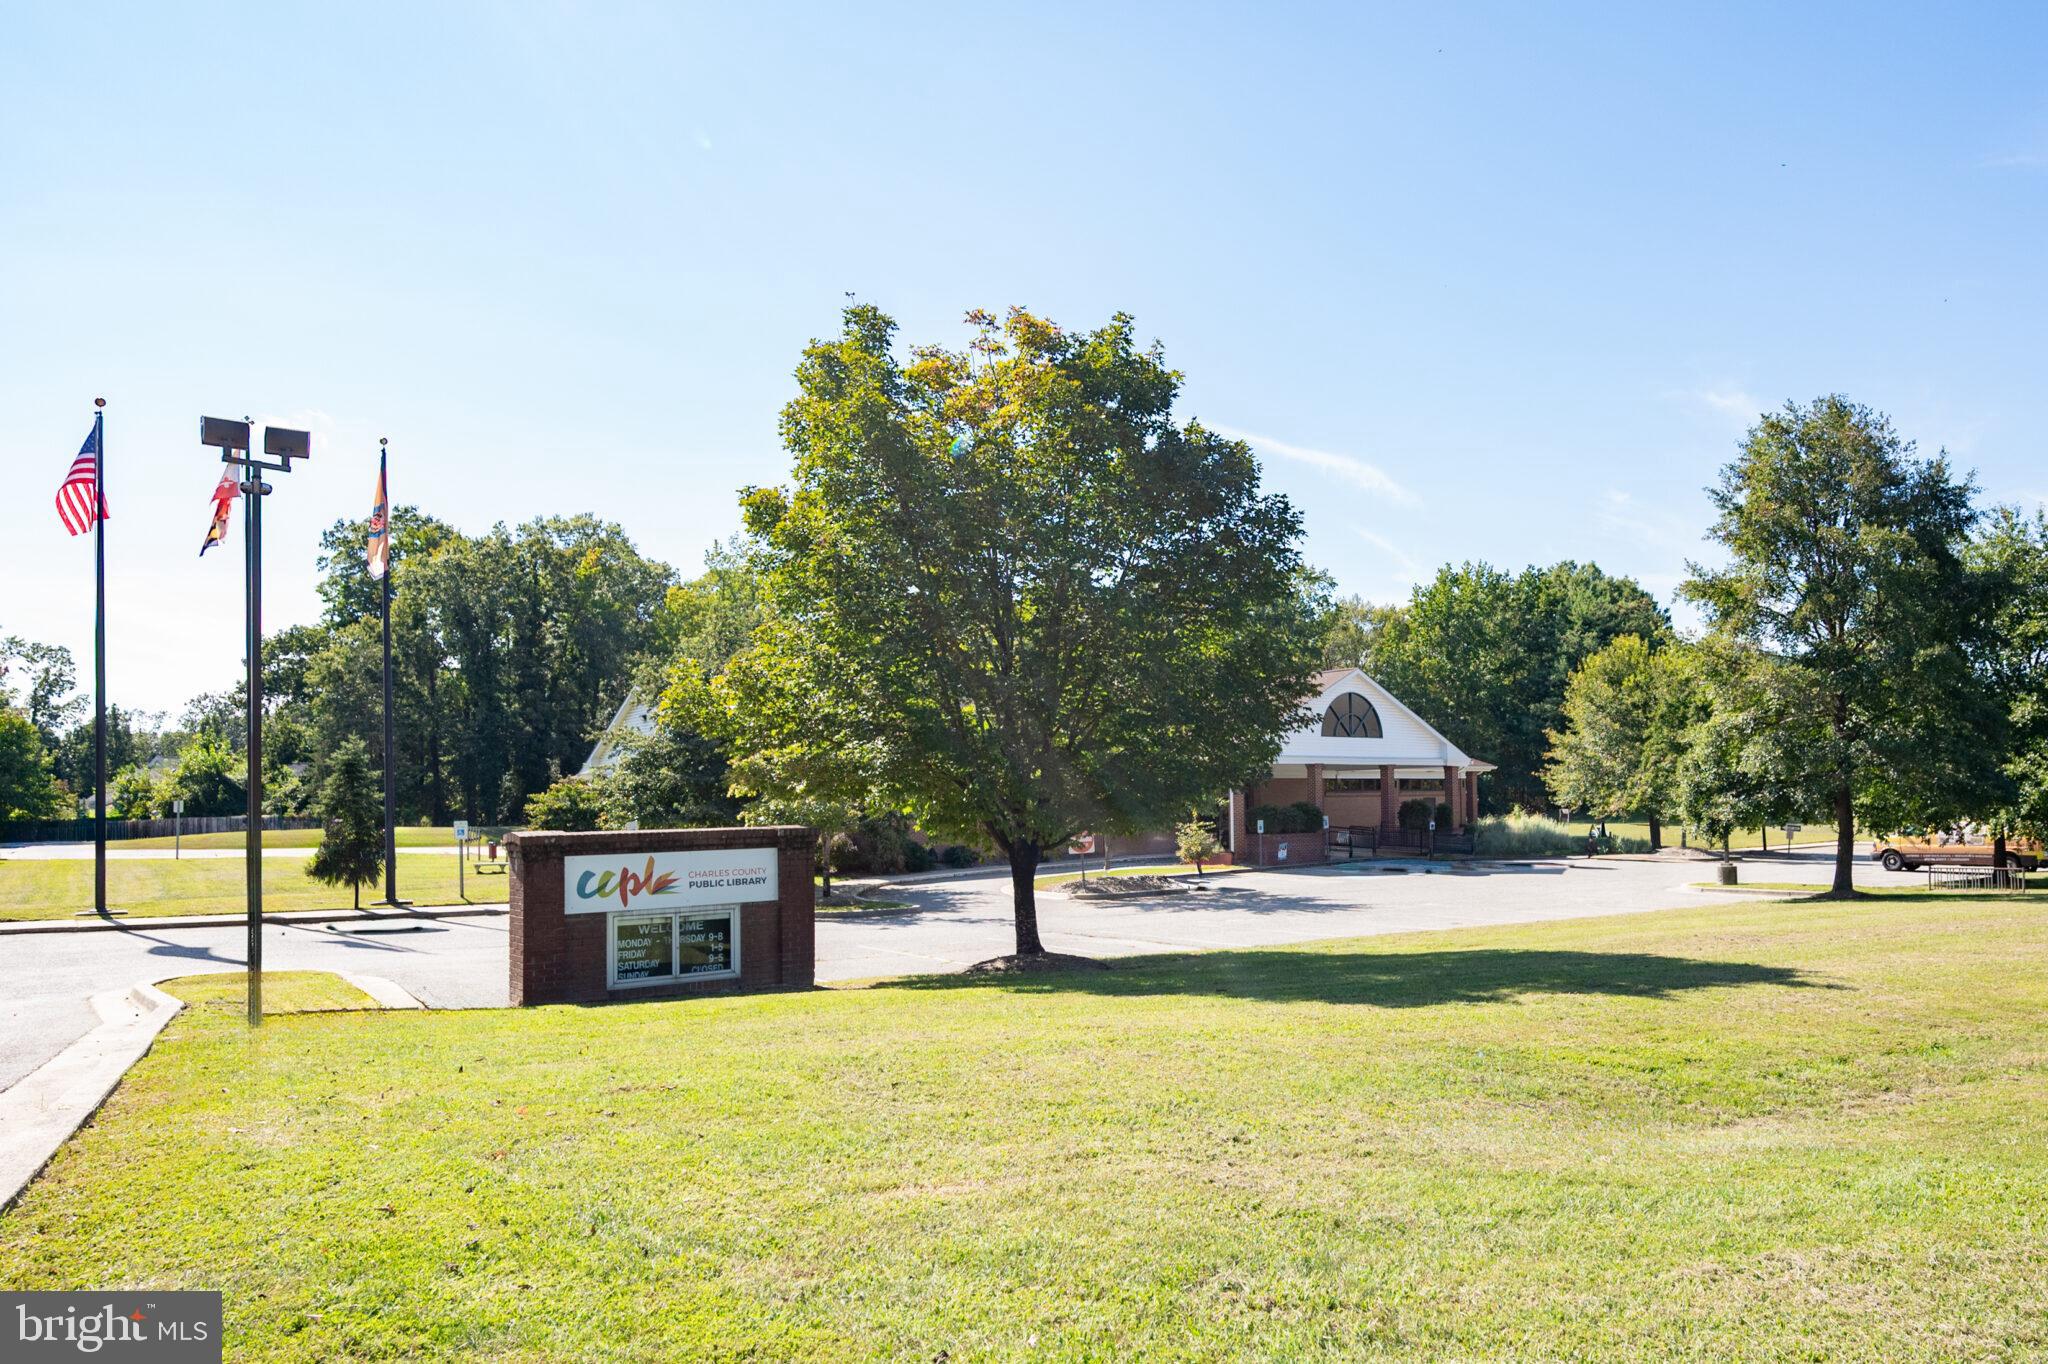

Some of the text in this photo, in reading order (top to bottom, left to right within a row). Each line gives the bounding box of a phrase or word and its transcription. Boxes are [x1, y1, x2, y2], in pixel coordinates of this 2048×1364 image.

[688, 867, 767, 879] CHARLES COUNTY
[689, 876, 767, 889] PUBLIC LIBRARY
[617, 938, 652, 949] MONDAY
[663, 933, 706, 945] THRSDAY
[708, 932, 724, 942] 9-8
[617, 942, 724, 960] FRIDAY 1-5
[617, 953, 724, 971] SATURDAY 9-5
